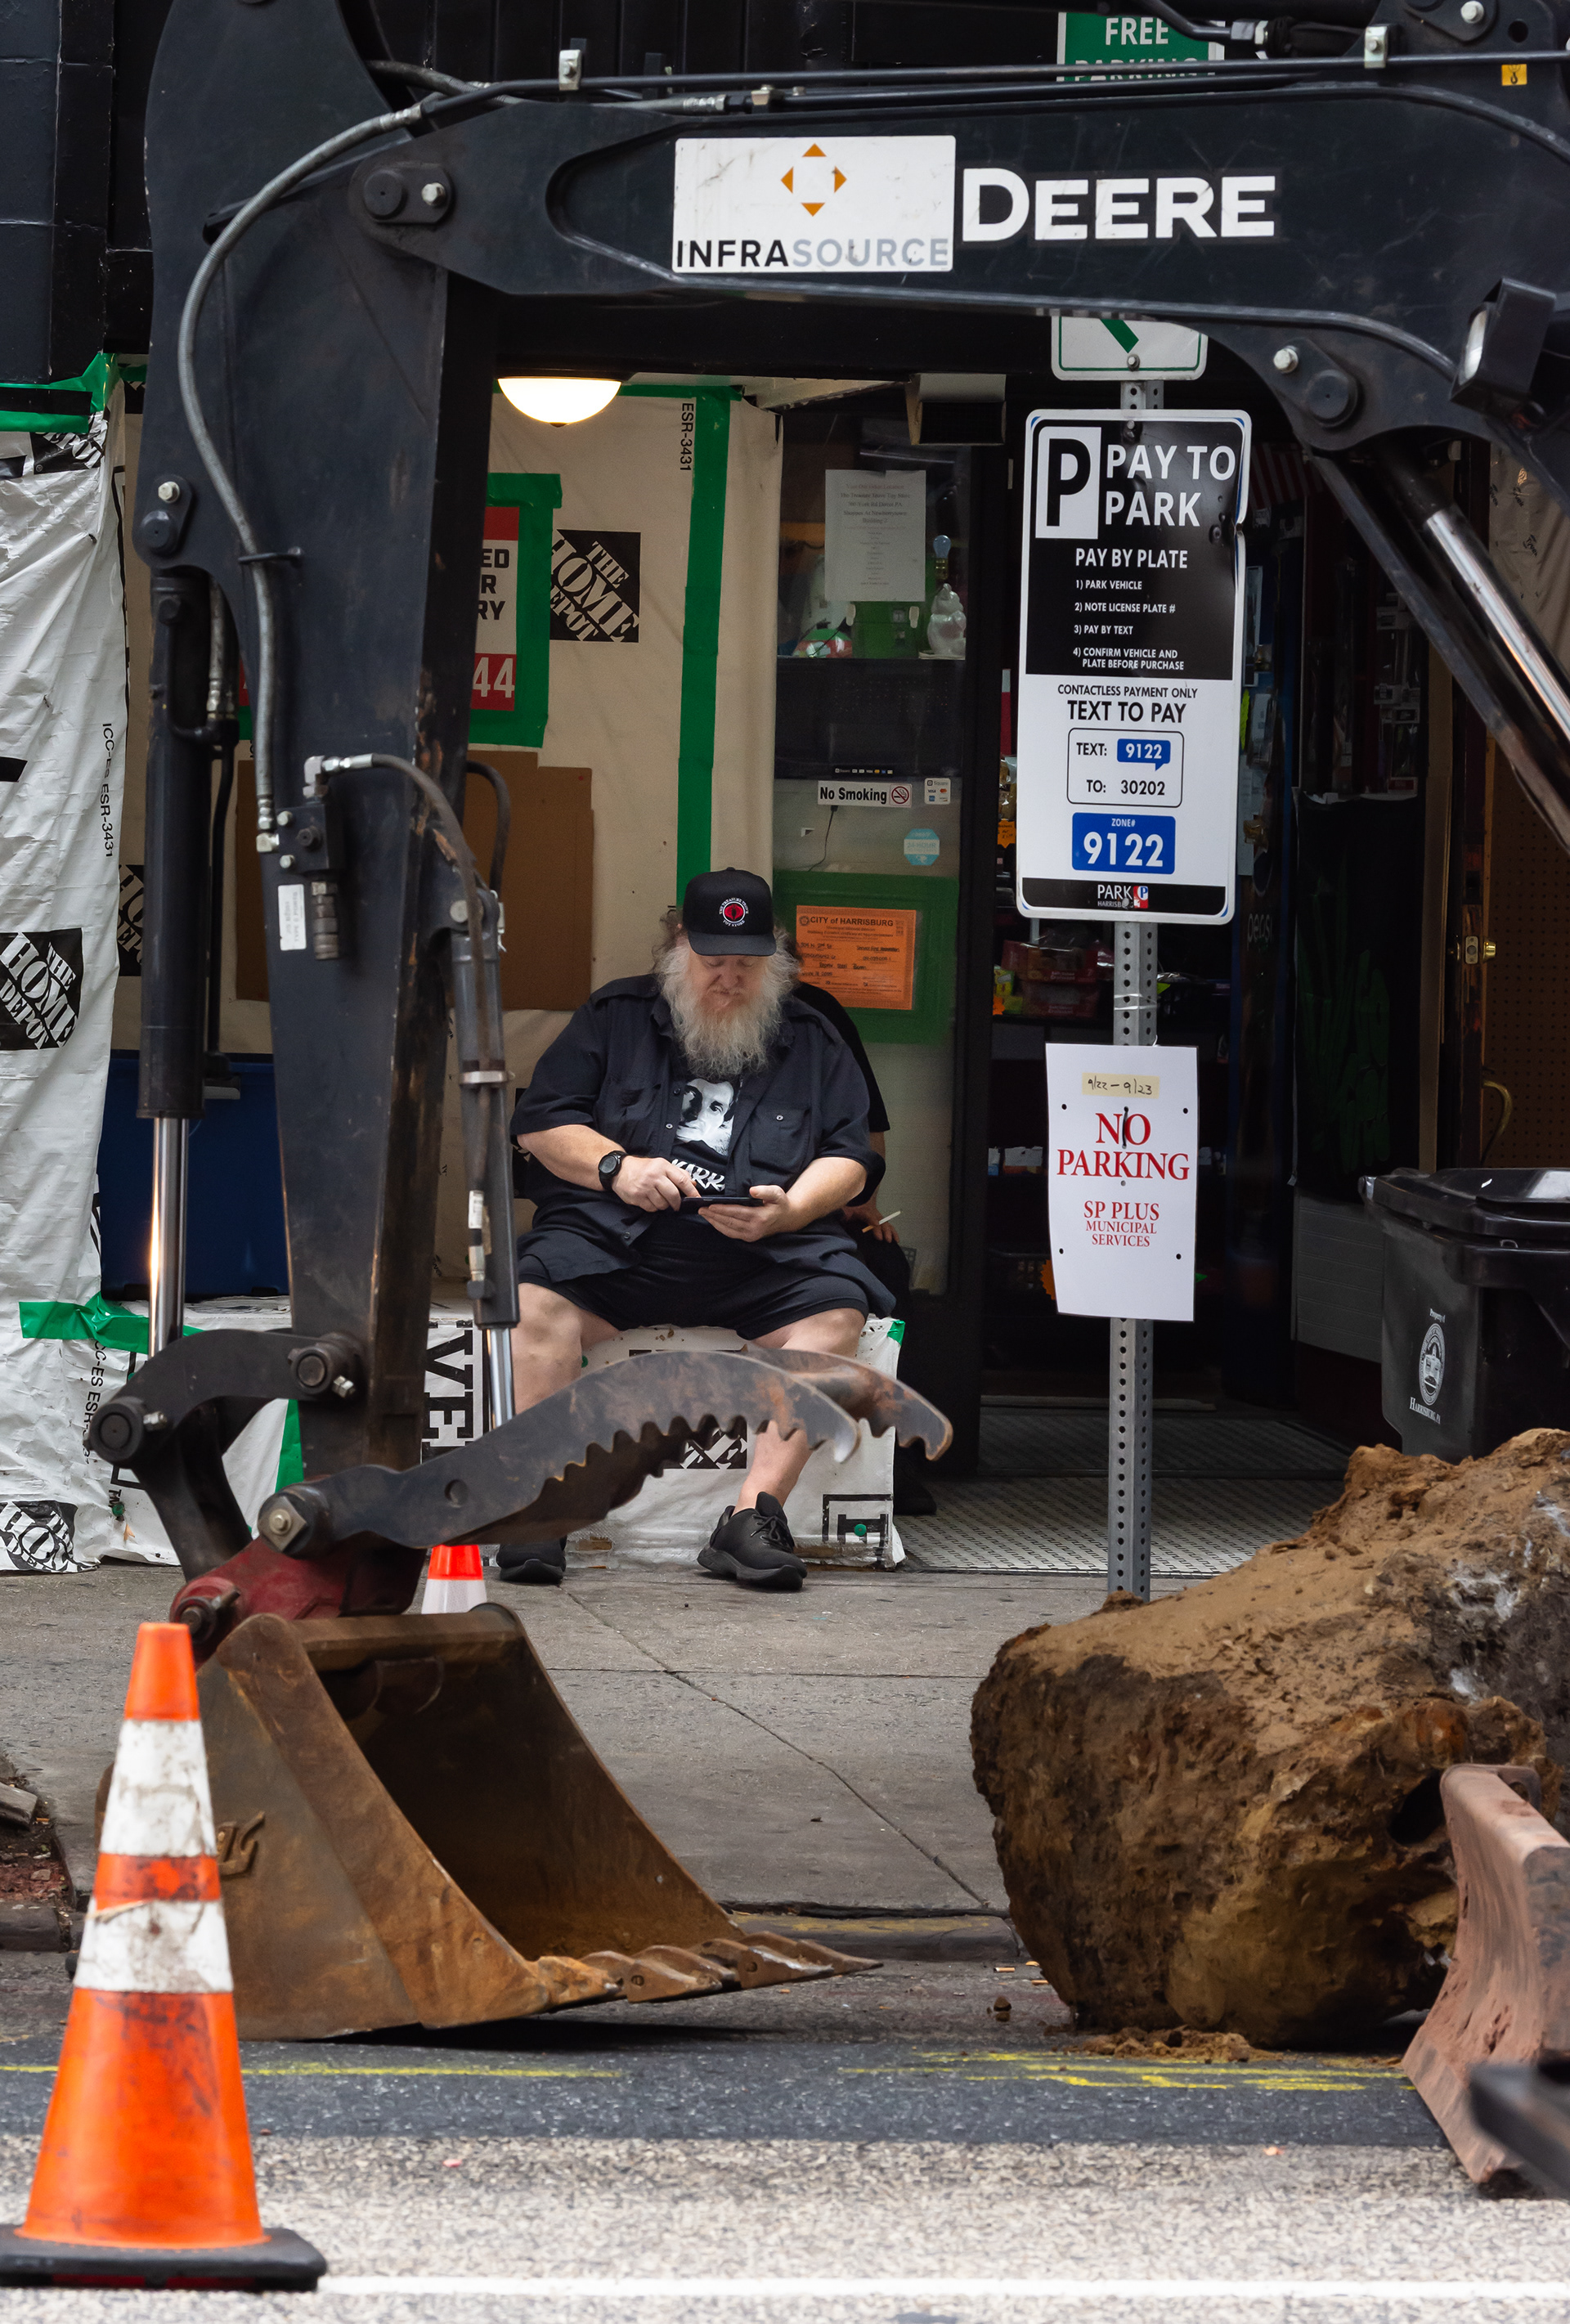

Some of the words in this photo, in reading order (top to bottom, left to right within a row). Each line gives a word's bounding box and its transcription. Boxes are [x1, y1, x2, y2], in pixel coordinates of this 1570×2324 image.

[1105, 17, 1169, 46] FREE
[962, 168, 1276, 243] DEERE
[676, 238, 949, 268] INFRASOURCE
[680, 402, 694, 473] ESR-3431
[1106, 444, 1178, 480] PAY
[1187, 446, 1236, 481] TO
[1047, 438, 1092, 527] P
[1105, 491, 1202, 527] PARK
[585, 541, 630, 589] THE
[1075, 548, 1107, 567] PAY
[1112, 549, 1133, 568] BY
[1137, 550, 1188, 569] PLATE
[1075, 579, 1083, 590] 1)
[1085, 580, 1107, 590] PARK
[1110, 581, 1142, 590] VEHICLE
[550, 585, 599, 641] EPOT
[1074, 603, 1083, 613] 2)
[1084, 603, 1107, 612] NOTE
[1109, 603, 1141, 612] LICENSE
[1142, 604, 1167, 613] PLATE
[1169, 604, 1176, 614] #
[1074, 625, 1082, 635] 3)
[1083, 626, 1099, 635] PAY
[1101, 626, 1112, 635] BY
[1114, 626, 1133, 635] TEXT
[1073, 647, 1081, 657] 4)
[1083, 648, 1122, 657] CONFIRM
[1124, 648, 1156, 658] VEHICLE
[1159, 649, 1178, 658] AND
[1082, 658, 1106, 668] PLATE
[1108, 659, 1139, 669] BEFORE
[1141, 660, 1184, 670] PURCHASE
[1057, 684, 1121, 697] CONTACTLESS
[1124, 686, 1169, 698] PAYMENT
[1173, 688, 1198, 698] ONLY
[1067, 700, 1112, 720] TEXT
[1118, 702, 1143, 723] TO
[1151, 702, 1186, 724] PAY
[1076, 742, 1107, 756] TEXT:
[1125, 743, 1162, 760] 9122
[820, 787, 835, 800] No
[838, 787, 887, 805] Smoking
[1086, 779, 1106, 793] TO:
[1121, 780, 1165, 796] 30202
[100, 783, 114, 857] ESR-3431
[1111, 818, 1136, 828] ZONE#
[1083, 831, 1164, 868] 9122
[1097, 885, 1133, 900] PARK
[1097, 900, 1134, 909] HARRISB
[840, 917, 894, 926] HARRISBURG
[1088, 1075, 1108, 1091] 9/22
[1124, 1079, 1152, 1096] 9/23
[1096, 1112, 1151, 1146] NO
[1056, 1149, 1190, 1181] PARKING
[1083, 1200, 1106, 1218] SP
[1111, 1201, 1160, 1221] PLUS
[1085, 1221, 1157, 1235] MUNICIPAL
[1092, 1234, 1150, 1247] SERVICES
[91, 1339, 106, 1387] CC-ES
